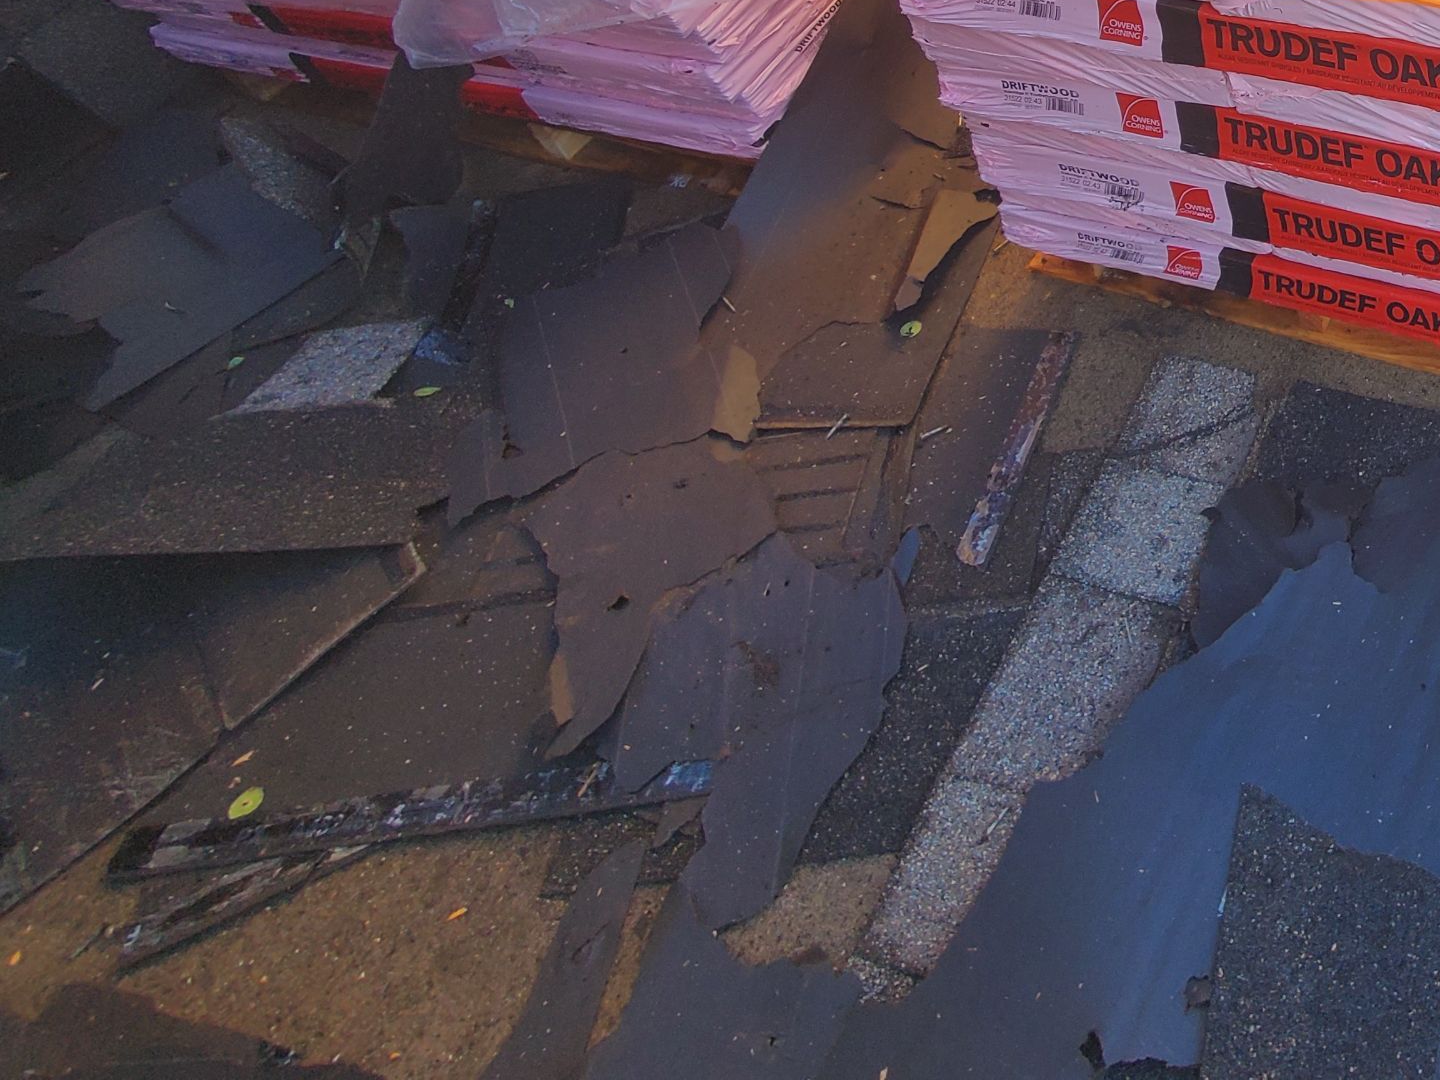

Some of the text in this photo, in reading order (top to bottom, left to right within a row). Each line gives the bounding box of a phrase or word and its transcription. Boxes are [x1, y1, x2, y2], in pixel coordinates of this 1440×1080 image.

[1103, 25, 1142, 40] CORNING
[1109, 18, 1142, 32] OWENS
[1207, 18, 1358, 71] TRUDEF
[1001, 80, 1080, 98] DRIFTWOOD
[1125, 120, 1162, 133] CORNING
[1131, 114, 1161, 127] OWENS
[1224, 117, 1364, 169] TRUDEF
[1179, 207, 1214, 221] CORNING
[1184, 202, 1213, 214] OWENS
[1272, 207, 1406, 256] TRUDEF
[1257, 270, 1378, 314] TRUDEF
